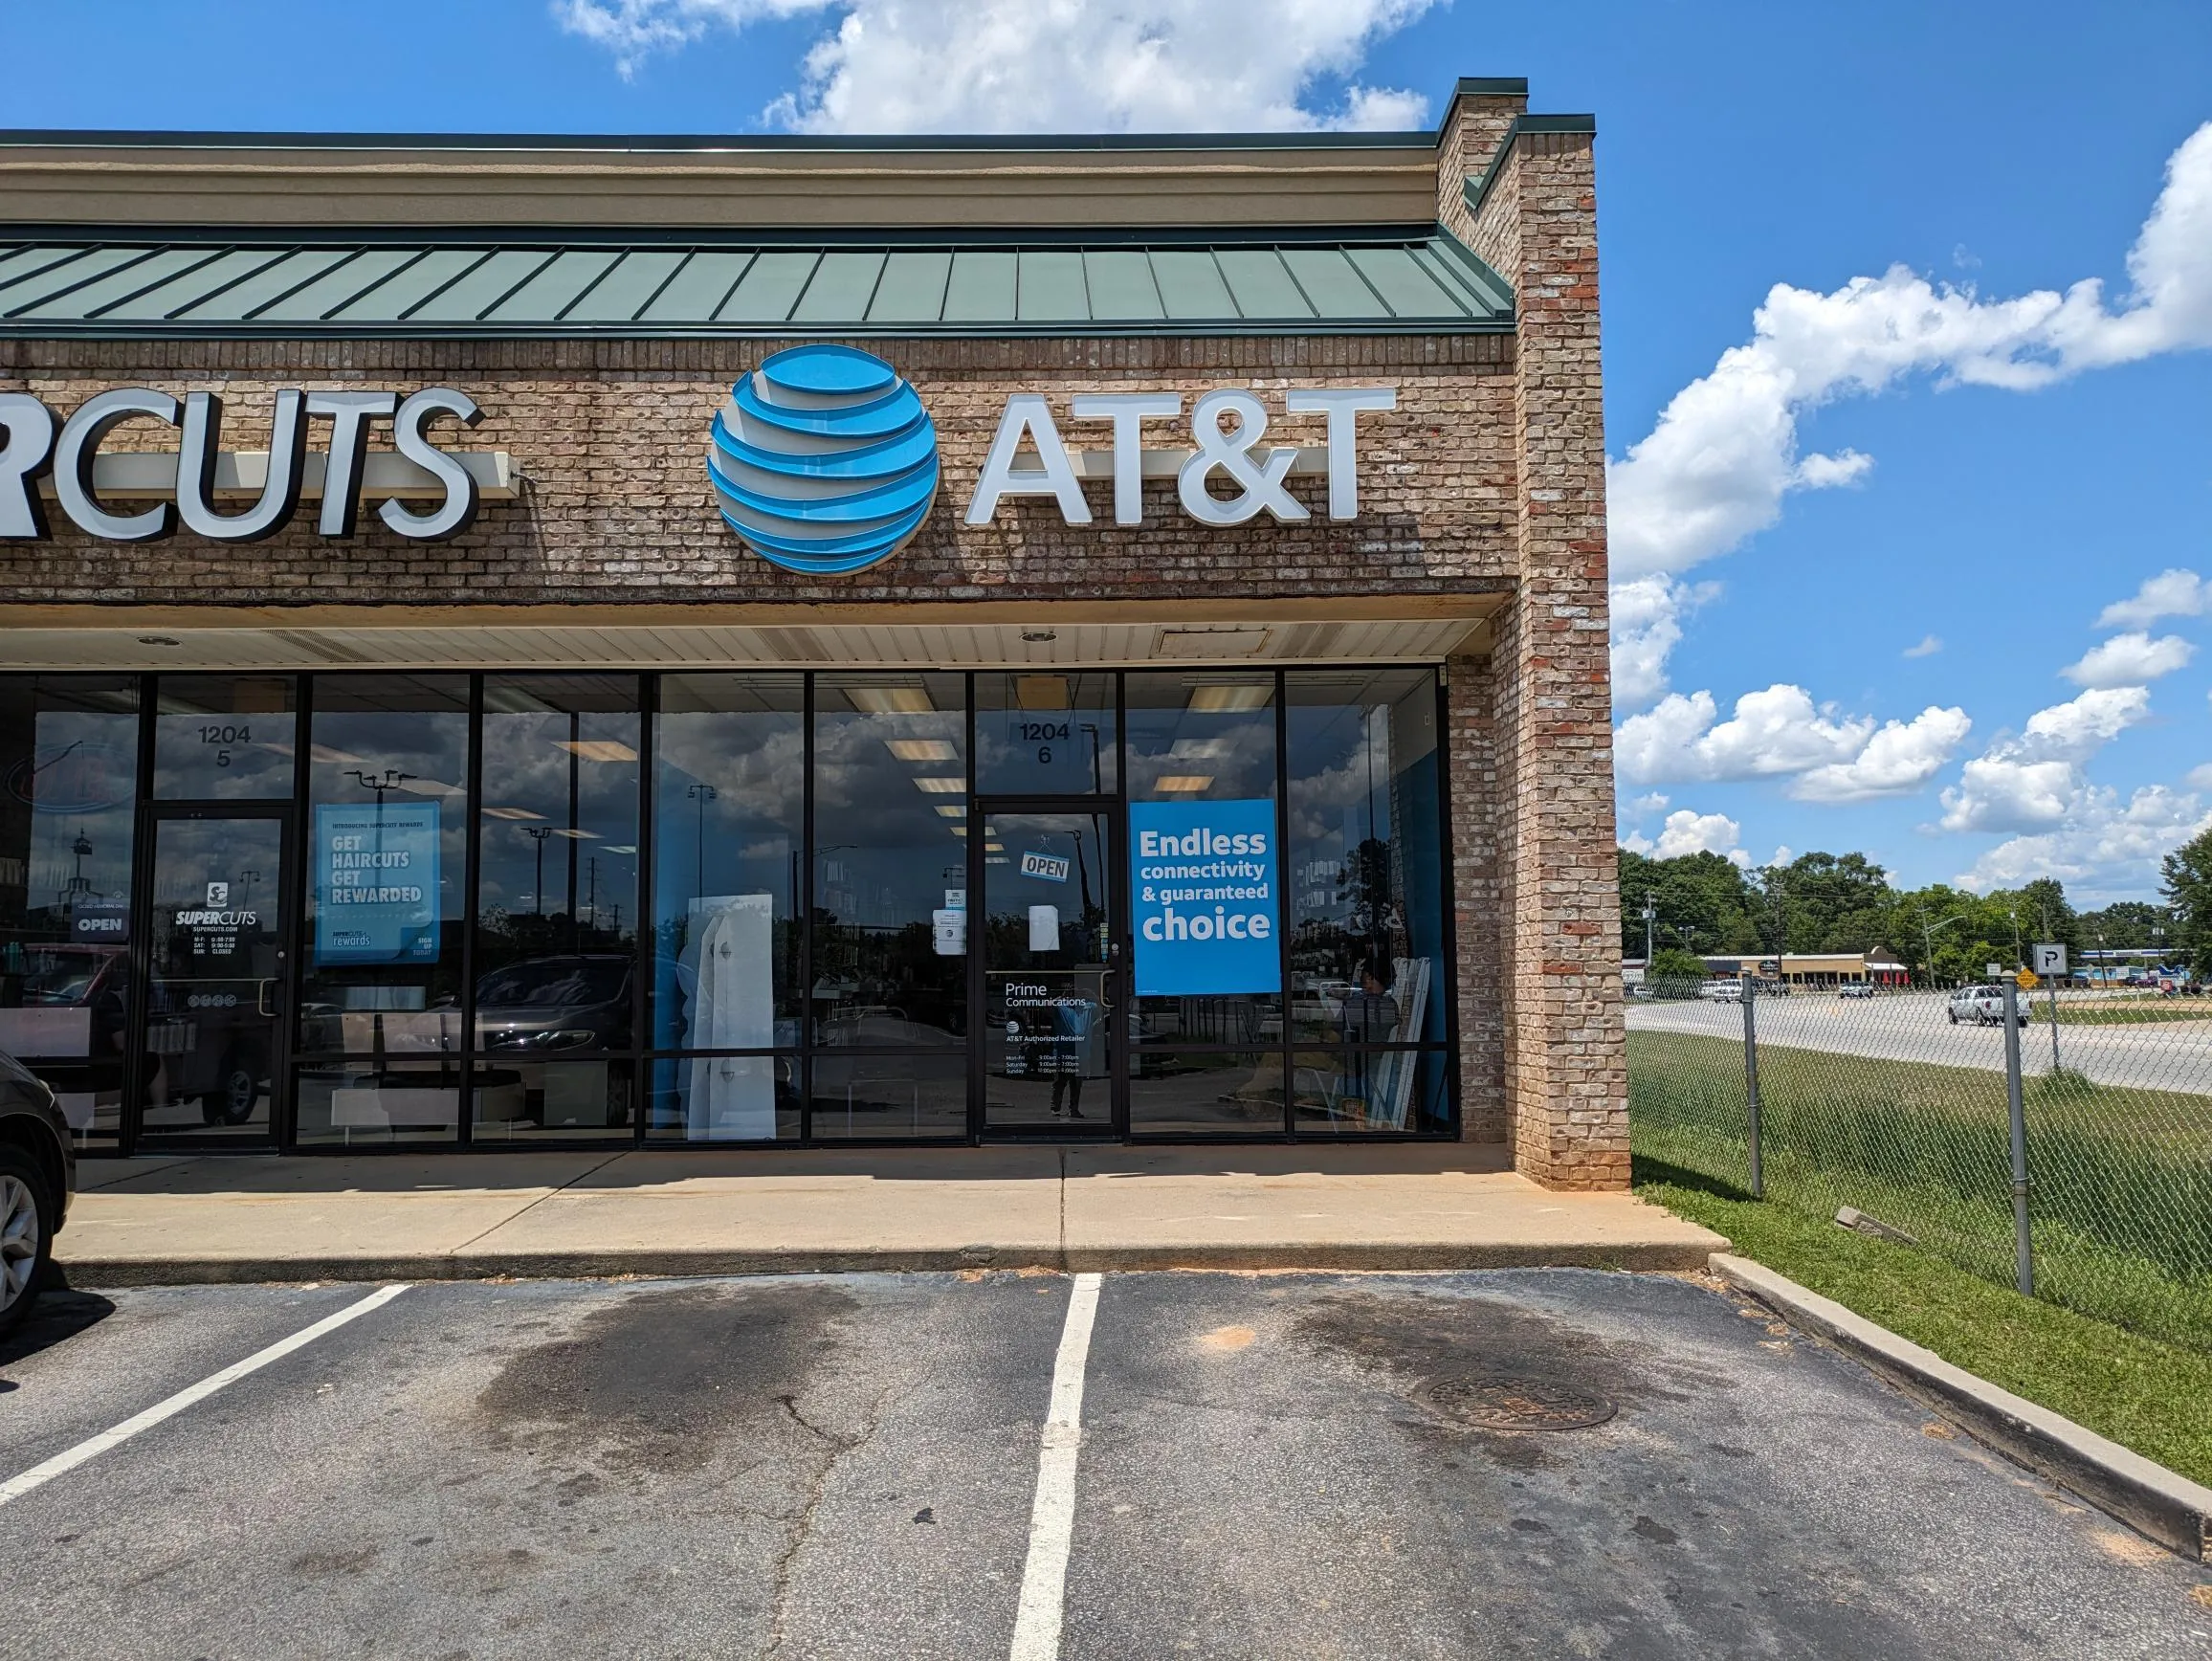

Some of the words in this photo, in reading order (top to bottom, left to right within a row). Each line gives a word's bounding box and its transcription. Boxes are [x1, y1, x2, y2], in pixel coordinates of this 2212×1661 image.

[964, 387, 1396, 527] AT&T
[198, 725, 252, 743] 1204
[1019, 722, 1071, 741] 1204
[216, 749, 231, 767] 5
[1038, 746, 1051, 764] 6
[331, 835, 362, 851] GET
[1139, 828, 1267, 857] Endless
[331, 852, 409, 869] HAIRCUTS
[1027, 856, 1066, 877] OPEN
[331, 870, 361, 886] GET
[1140, 859, 1266, 881] connectivity
[331, 886, 422, 904] REWARDED
[1141, 886, 1157, 902] &
[1160, 882, 1269, 906] guaranteed
[77, 918, 122, 932] OPEN
[175, 910, 257, 926] SUPERCUTS
[1142, 905, 1271, 941] choice
[332, 935, 370, 946] rewards
[2045, 950, 2059, 967] P
[1006, 982, 1048, 996] Prime
[1006, 997, 1087, 1007] Communications
